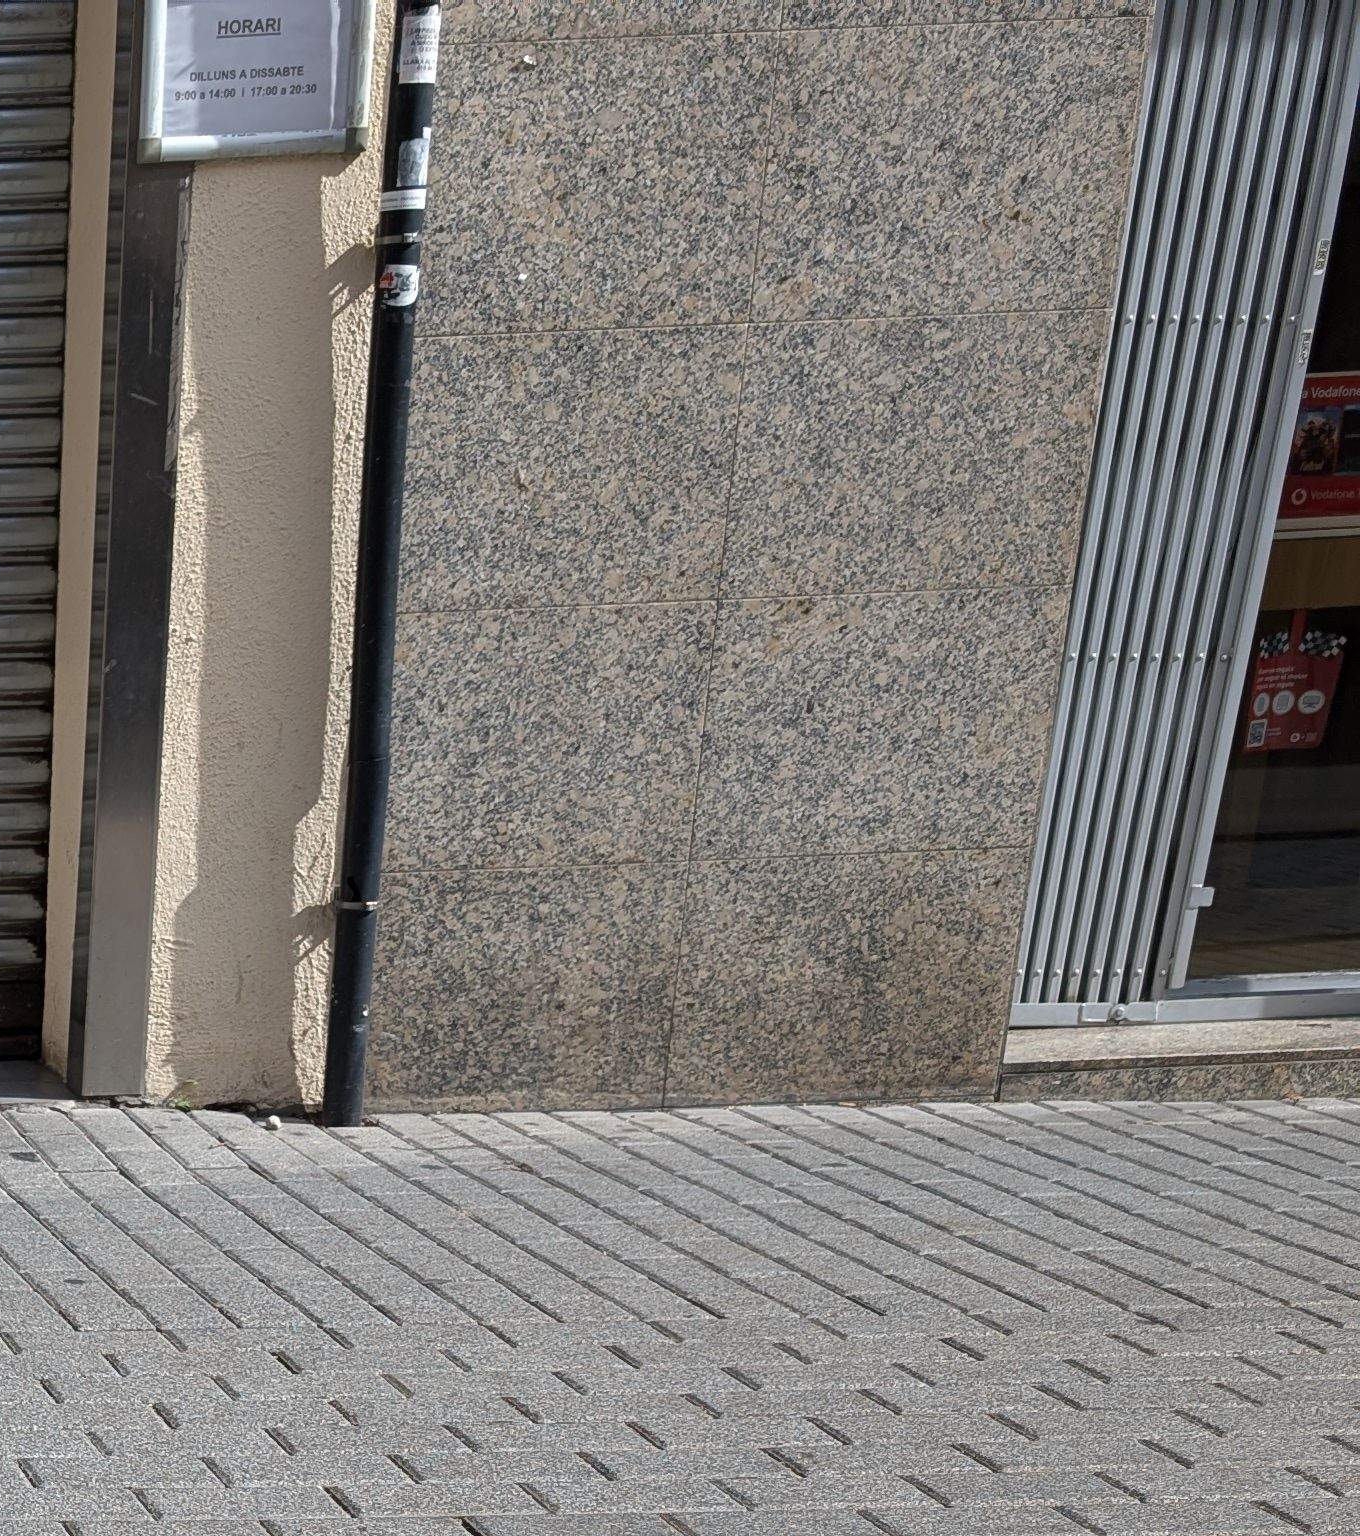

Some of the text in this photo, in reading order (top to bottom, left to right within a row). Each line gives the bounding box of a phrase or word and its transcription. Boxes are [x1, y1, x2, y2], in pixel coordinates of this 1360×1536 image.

[217, 18, 281, 35] HORARI
[189, 66, 304, 82] DILLUNS A DISSABTE
[175, 91, 196, 101] 9:00
[209, 88, 236, 98] 14:00
[251, 86, 278, 96] 17:00
[290, 84, 317, 94] 20:30
[1311, 490, 1355, 500] Vodafone
